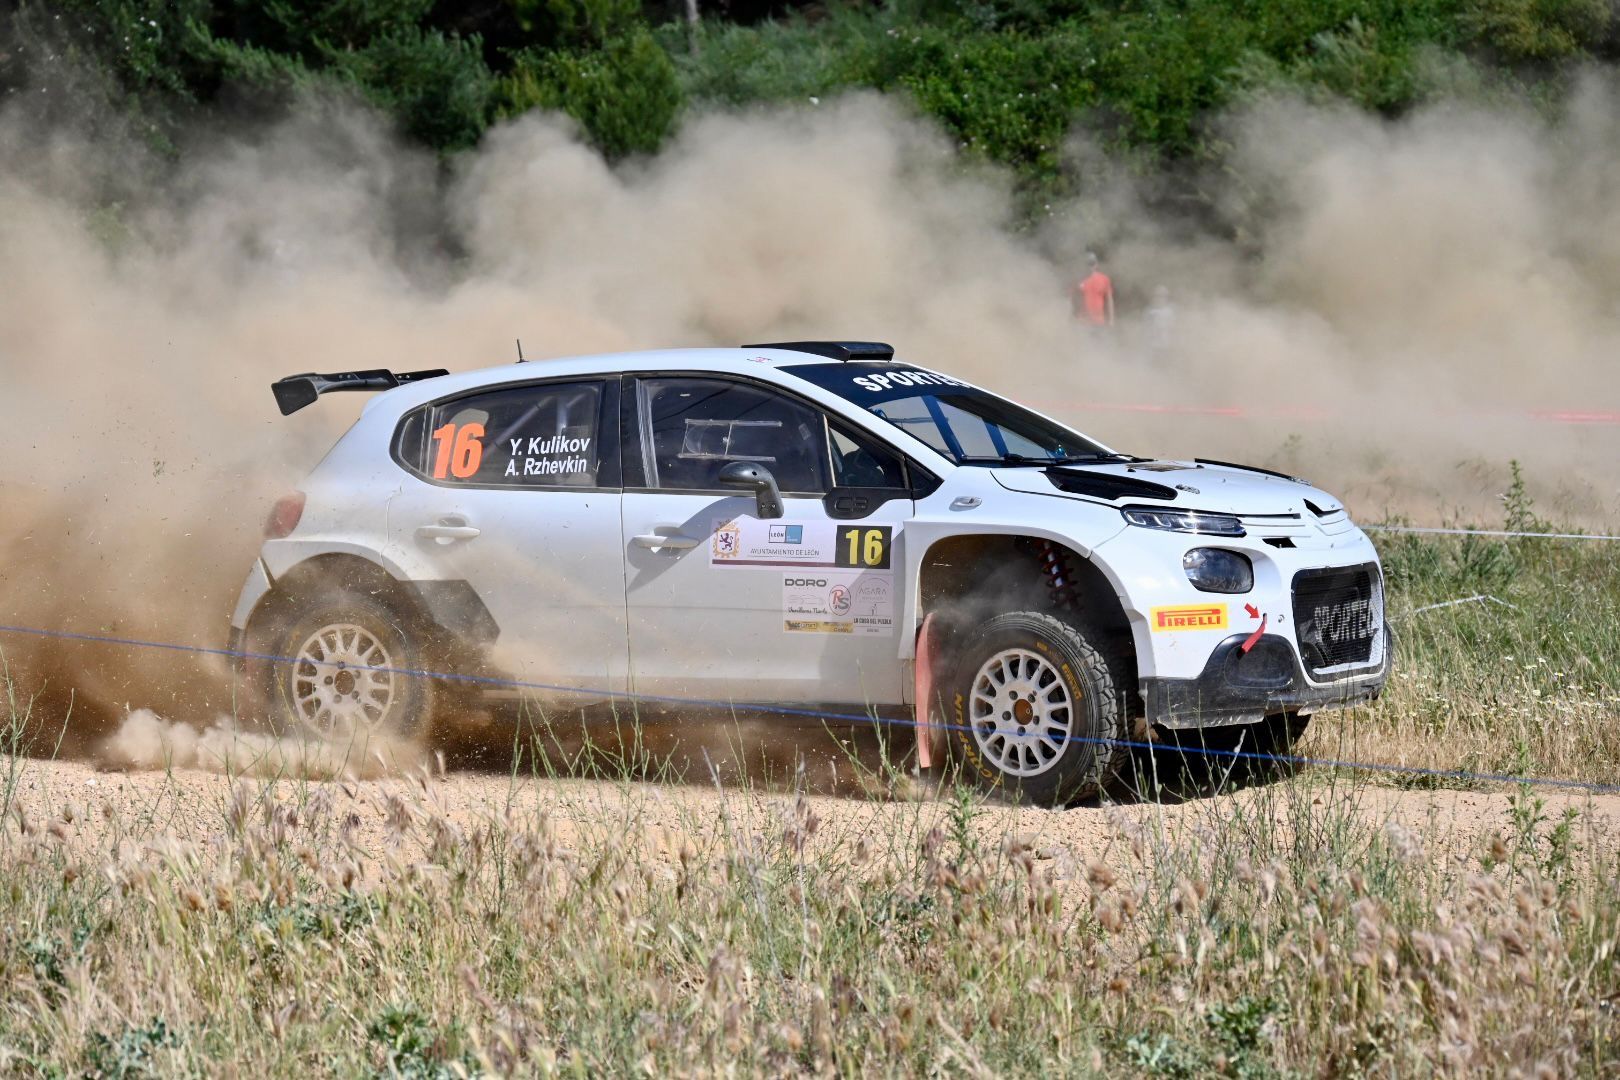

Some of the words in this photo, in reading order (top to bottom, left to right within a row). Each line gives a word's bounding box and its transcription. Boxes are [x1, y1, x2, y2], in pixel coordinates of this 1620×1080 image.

[852, 371, 970, 392] SPORTE
[432, 422, 485, 480] 16
[509, 438, 523, 456] Y.
[527, 435, 591, 455] Kulikov
[504, 458, 520, 477] A.
[523, 456, 588, 476] Rzhevkin
[845, 529, 883, 566] 16
[784, 578, 828, 588] DORO
[1157, 609, 1221, 627] PIRELLI
[954, 692, 1004, 787] SCORPON
